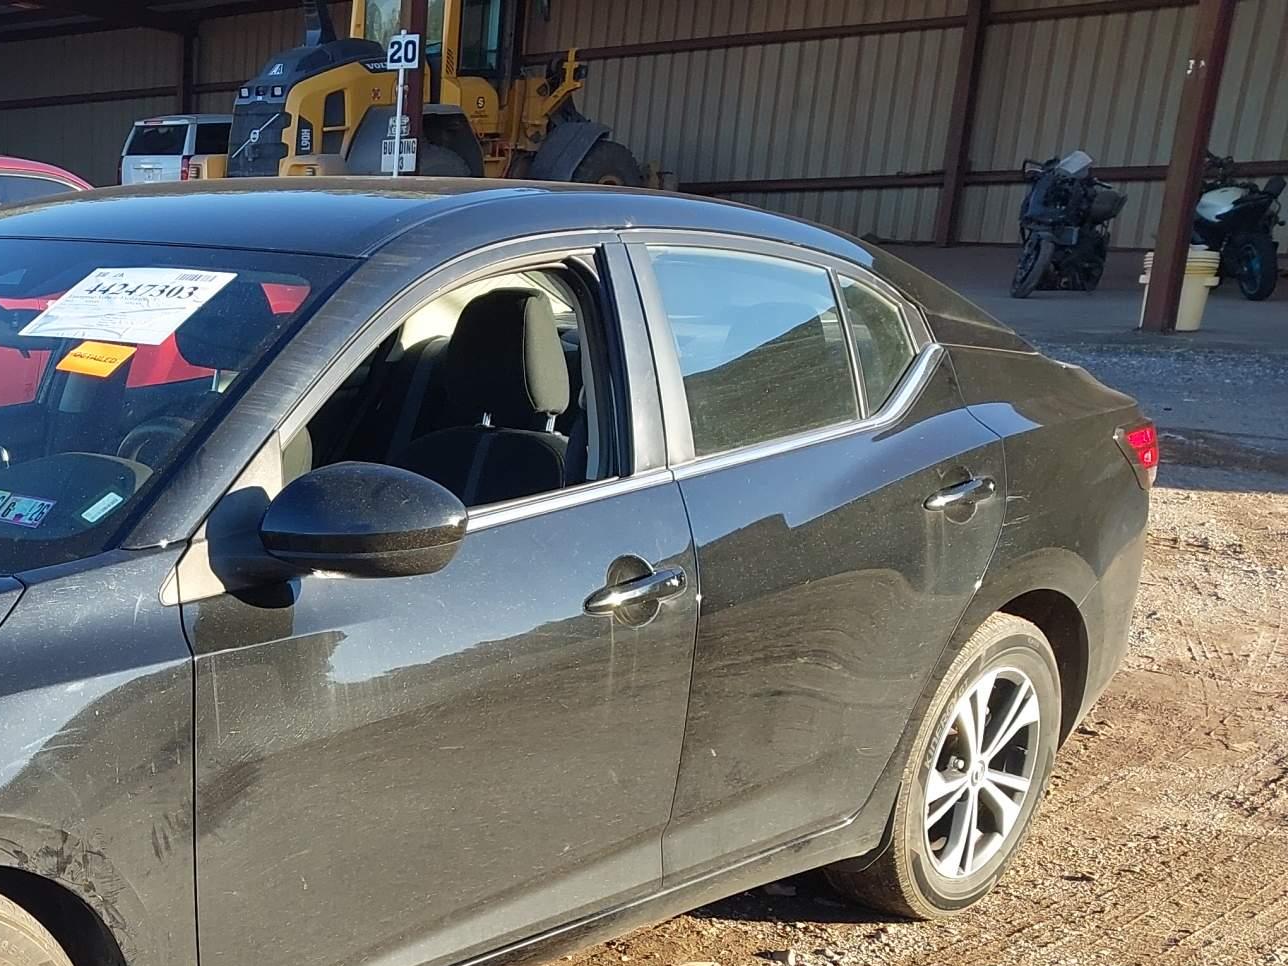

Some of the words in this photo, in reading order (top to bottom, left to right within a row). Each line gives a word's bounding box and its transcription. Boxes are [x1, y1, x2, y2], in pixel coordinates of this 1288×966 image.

[389, 39, 417, 64] 20
[300, 129, 311, 151] L90H
[383, 140, 416, 155] BUIDING
[85, 283, 199, 299] 44247303
